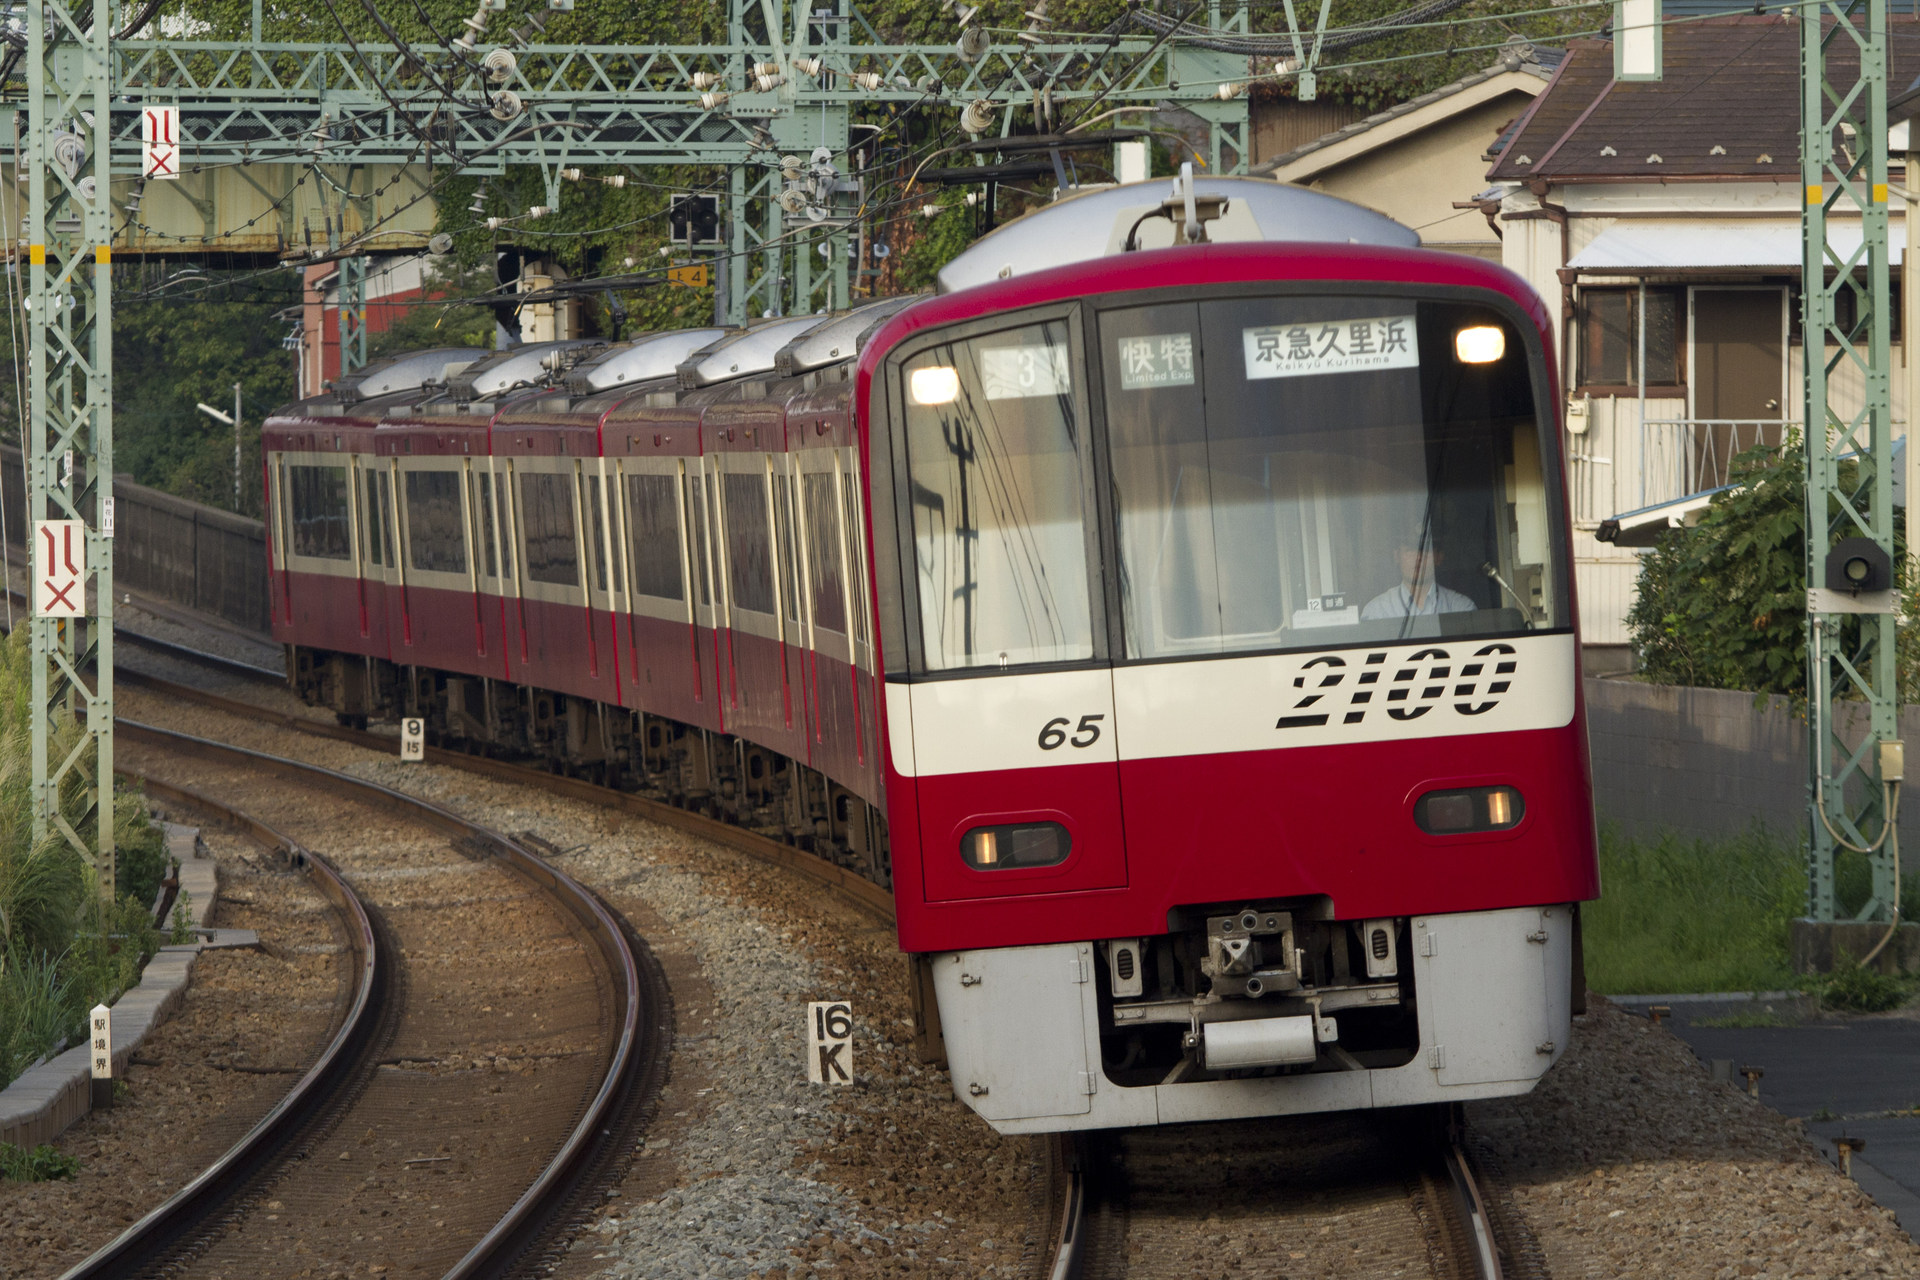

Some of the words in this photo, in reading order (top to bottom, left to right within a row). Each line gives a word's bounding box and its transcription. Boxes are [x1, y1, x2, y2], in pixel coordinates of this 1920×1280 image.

[1122, 336, 1193, 375] 快特
[1254, 319, 1407, 362] 京急久里浜
[1018, 351, 1035, 388] 3
[1125, 371, 1167, 384] Limited
[1171, 370, 1193, 380] Exp.
[1327, 356, 1390, 366] Kurihama
[1275, 643, 1517, 729] 2100
[407, 720, 420, 736] 9
[1037, 714, 1104, 751] 65
[407, 741, 420, 753] 15
[816, 1004, 852, 1040] 16
[819, 1044, 849, 1081] K
